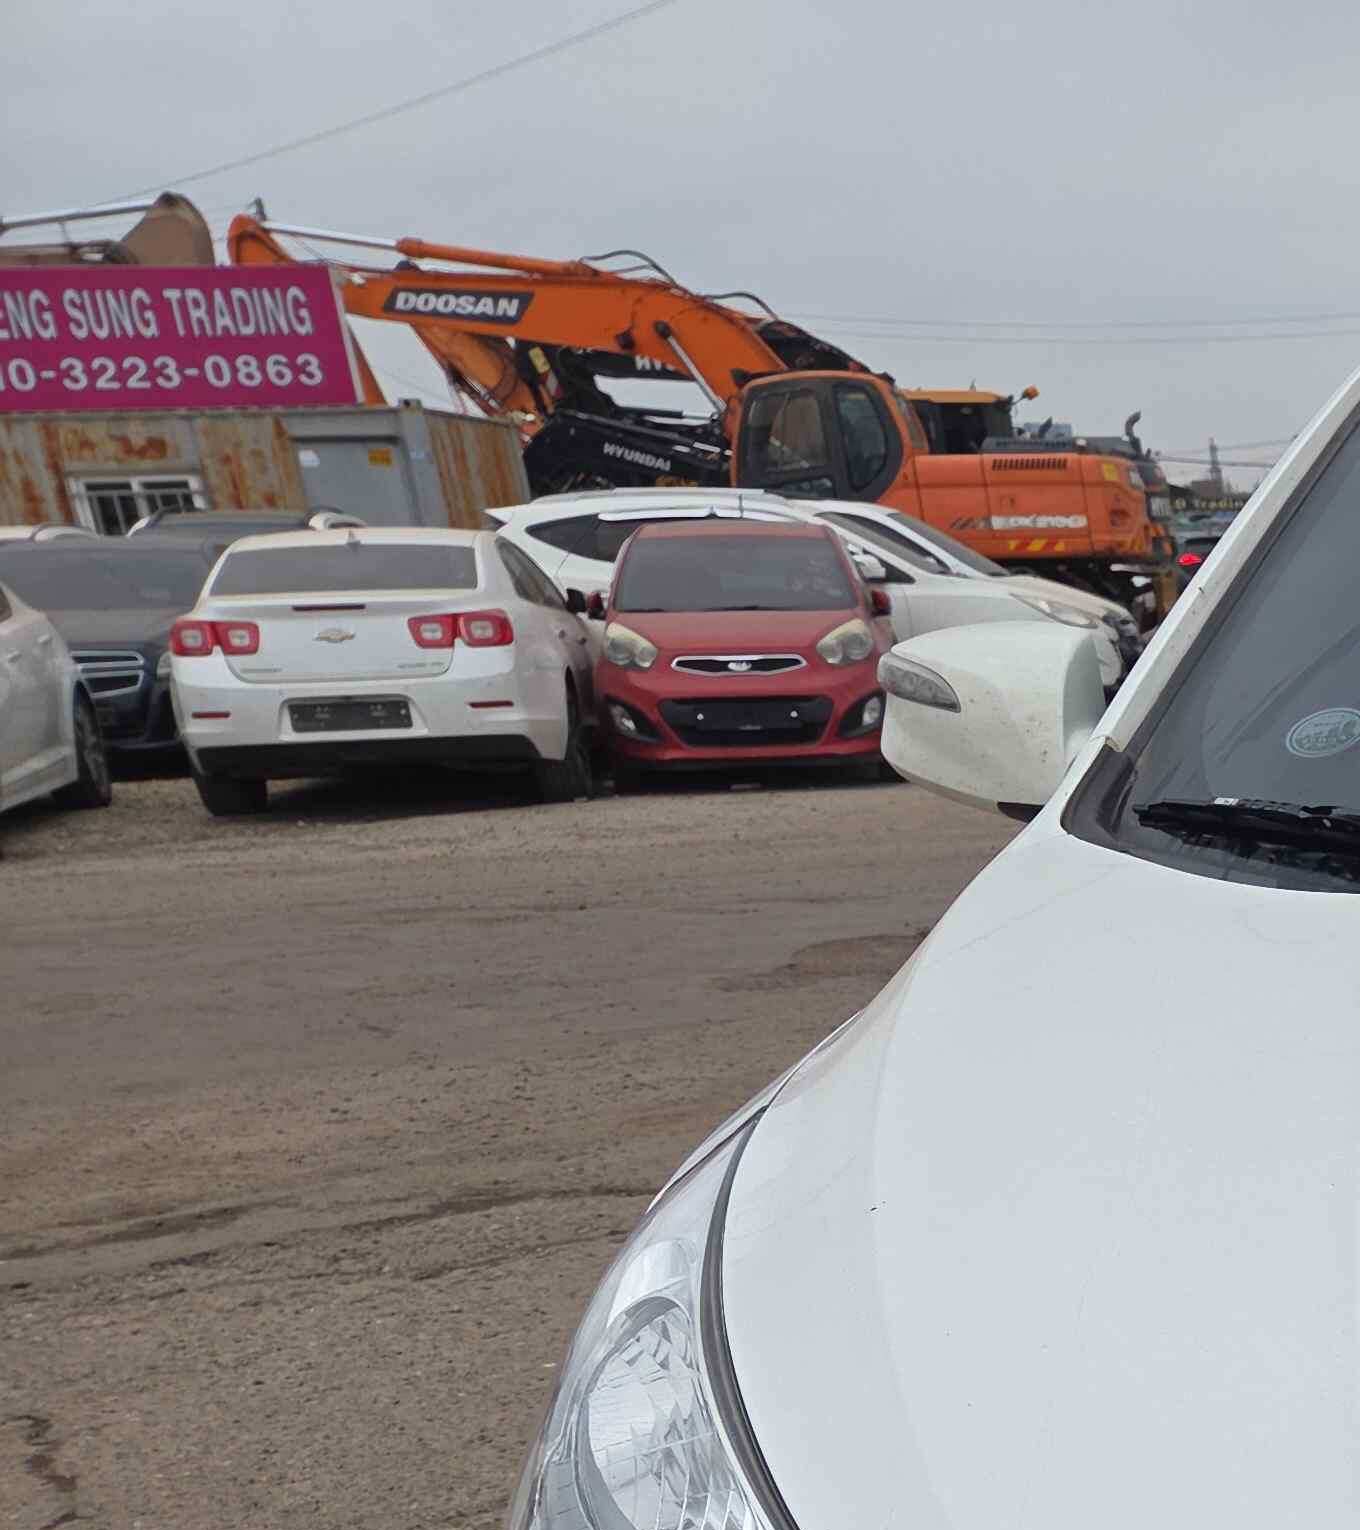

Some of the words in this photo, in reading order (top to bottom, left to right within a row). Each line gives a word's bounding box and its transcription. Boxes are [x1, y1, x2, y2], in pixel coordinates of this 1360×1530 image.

[62, 288, 159, 340] SUNG
[162, 286, 315, 337] TRADING
[394, 291, 520, 317] DOOSAN
[603, 442, 672, 472] HYUNDAI
